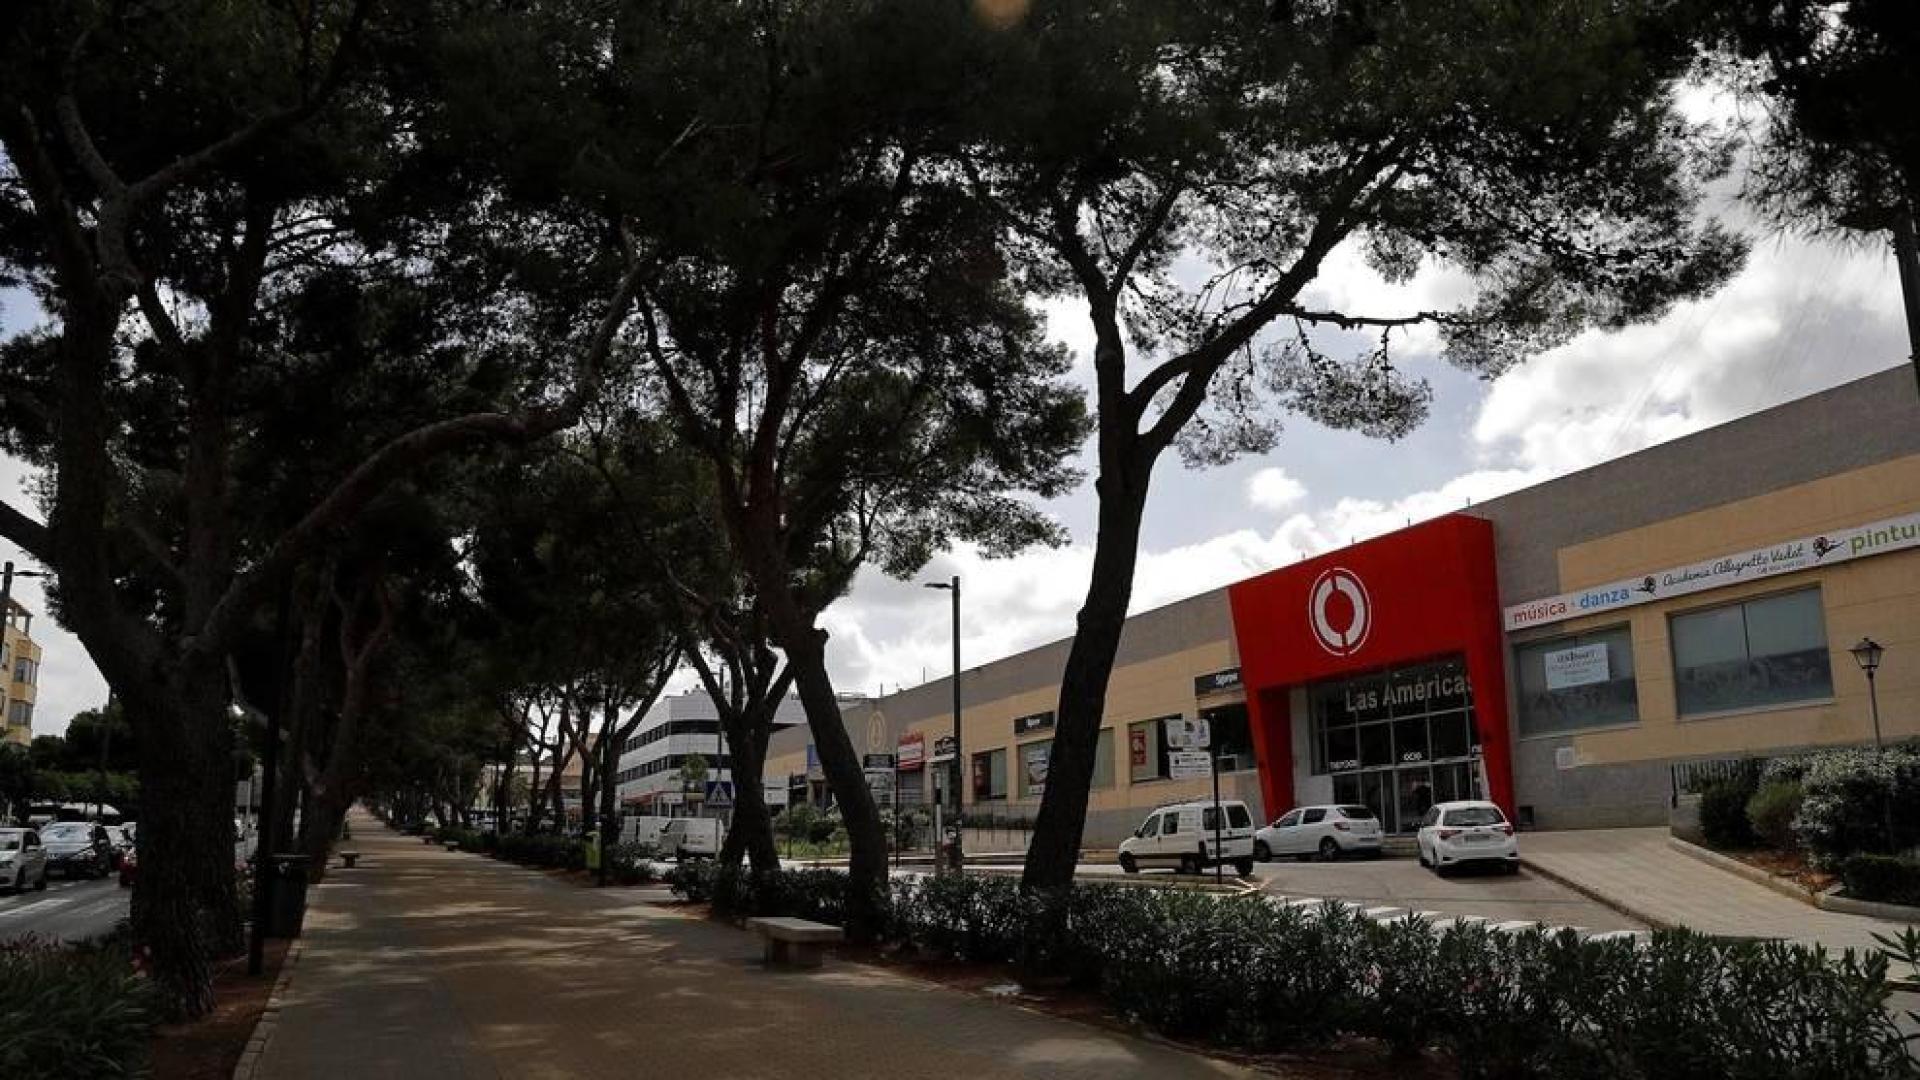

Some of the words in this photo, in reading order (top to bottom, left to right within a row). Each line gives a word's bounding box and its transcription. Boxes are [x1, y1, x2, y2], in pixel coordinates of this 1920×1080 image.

[1513, 601, 1567, 624] música
[1580, 587, 1630, 609] danza
[1850, 522, 1920, 556] pintu
[1345, 685, 1378, 713] Las
